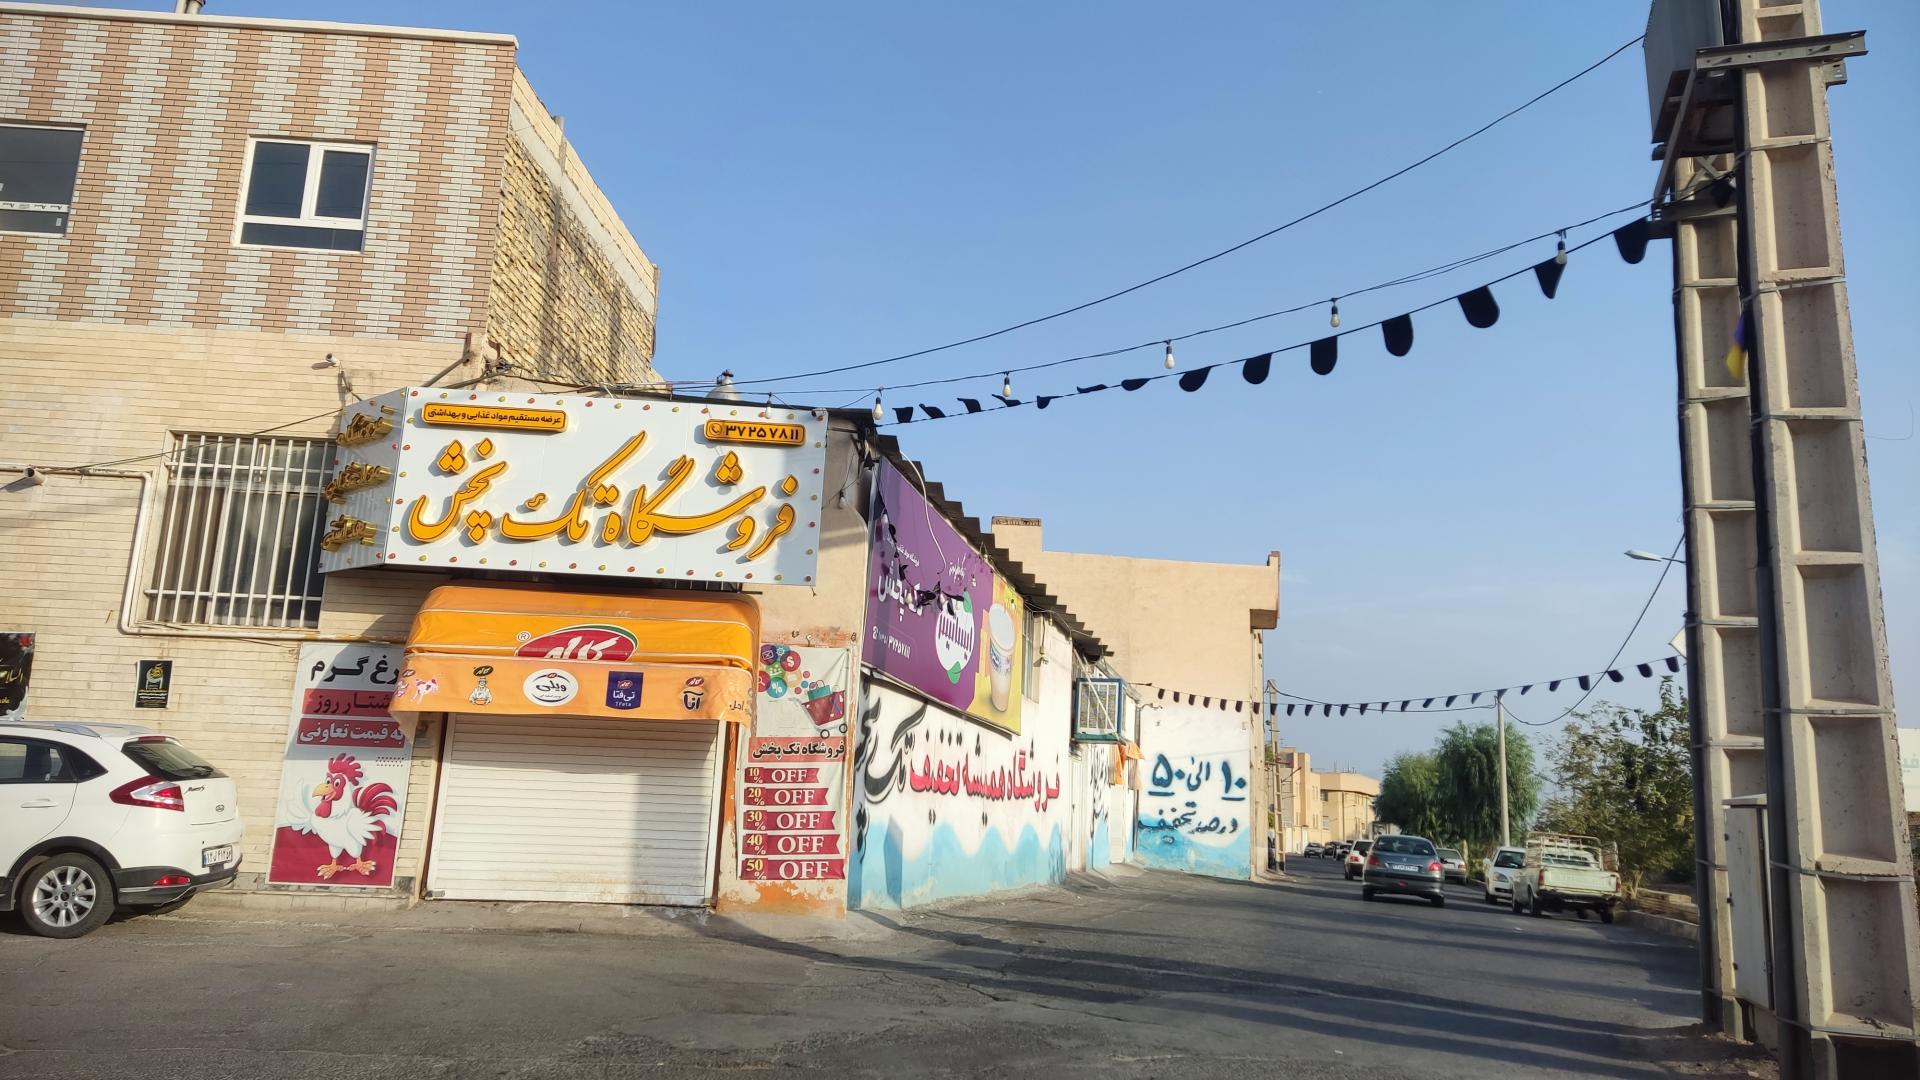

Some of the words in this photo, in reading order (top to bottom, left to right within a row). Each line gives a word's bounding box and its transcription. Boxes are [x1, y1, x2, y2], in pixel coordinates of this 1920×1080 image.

[427, 408, 461, 420] بهداشتی
[466, 410, 490, 421] غذایی
[491, 413, 508, 422] مواد
[508, 414, 540, 424] مستقیم
[541, 416, 561, 425] عرضه
[725, 425, 799, 440] ۳۷۲۵۷۸۱۱
[407, 438, 508, 545] پخش
[500, 430, 648, 544] تک
[600, 450, 800, 561] فروشگاه
[310, 655, 370, 682] گرم
[370, 654, 400, 685] رغ
[535, 680, 567, 692] ویلی
[313, 695, 339, 714] روز
[342, 692, 392, 714] شتار
[300, 722, 350, 742] تعاونی
[350, 723, 388, 744] قیمت
[752, 742, 782, 759] پخش
[783, 743, 800, 755] تک
[802, 741, 845, 758] فروشگاه
[771, 769, 808, 783] OFF
[909, 728, 963, 825] تخفیف
[962, 732, 1006, 826] همیشه
[1006, 738, 1060, 812] فروشگاه
[1152, 753, 1185, 788] ۵۰
[1221, 760, 1247, 794] ۱۰
[774, 789, 815, 804] OFF
[776, 812, 820, 829] OFF
[1188, 816, 1238, 834] درصد
[777, 836, 824, 853] OFF
[779, 861, 830, 879] OFF
